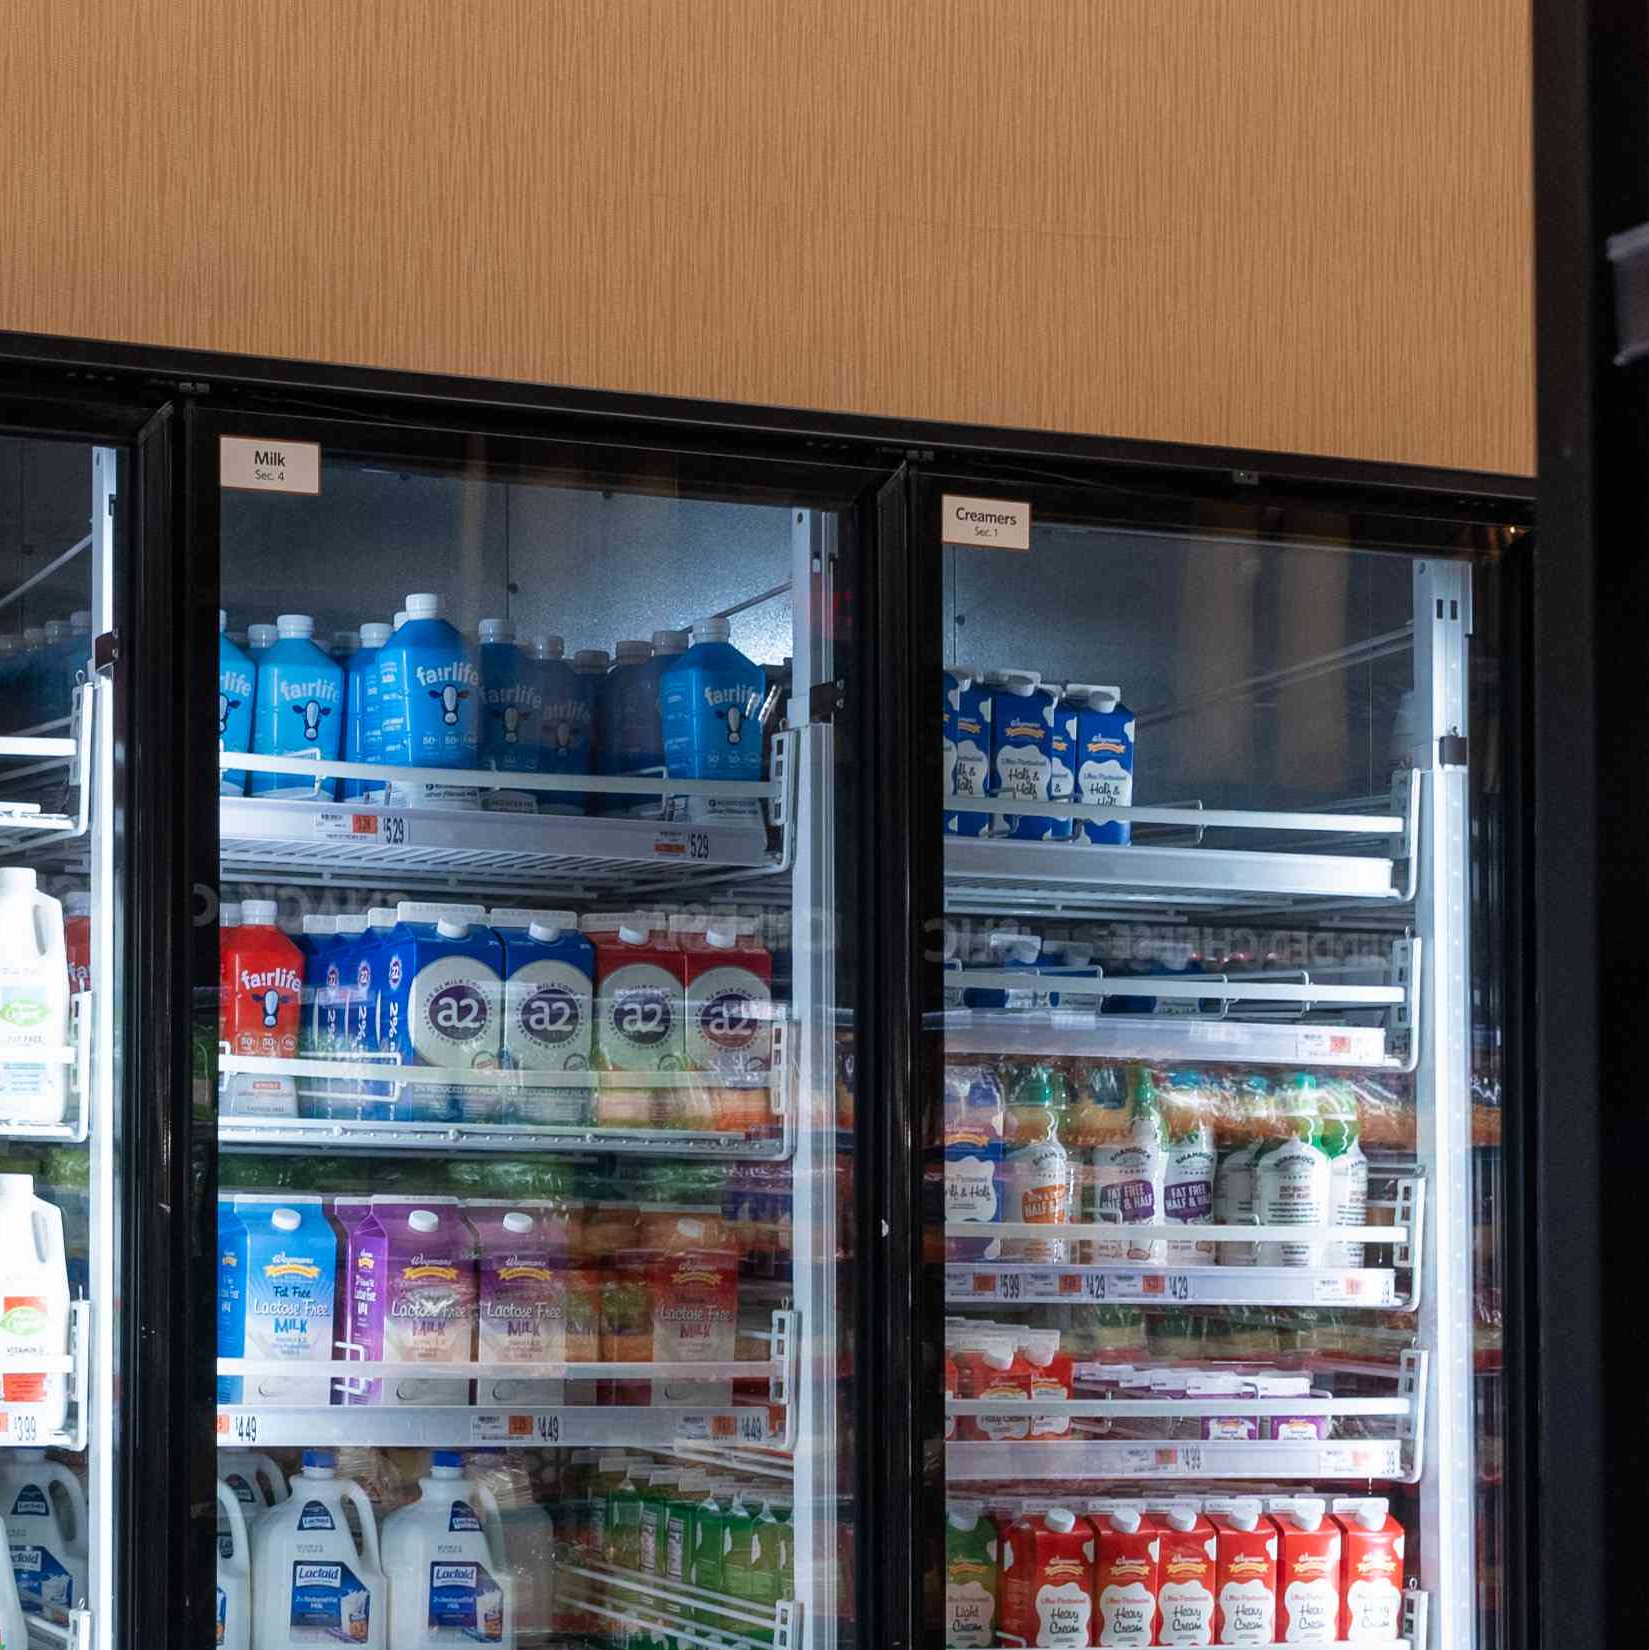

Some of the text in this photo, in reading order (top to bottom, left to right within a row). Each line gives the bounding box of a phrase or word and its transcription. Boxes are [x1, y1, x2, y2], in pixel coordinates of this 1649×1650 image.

[254, 451, 286, 468] Milk
[255, 469, 286, 482] Sec. 4
[955, 508, 1017, 526] Creamers
[416, 662, 479, 688] fairlife
[280, 678, 340, 702] fairlife
[478, 684, 542, 706] fairlife
[1008, 768, 1030, 783] Half
[241, 968, 302, 993] fairlife
[437, 996, 482, 1029] a2
[529, 1001, 575, 1031] a2
[621, 1002, 665, 1031] a2
[709, 1005, 751, 1035] a2
[1105, 1185, 1144, 1200] FAT FREE
[1170, 1185, 1207, 1198] FAT FREE
[272, 1252, 314, 1266] Wegmans
[411, 1254, 453, 1266] Wegmans
[505, 1256, 546, 1268] Wegmans
[273, 1286, 311, 1298] Fat Free
[253, 1299, 331, 1317] Lactose Free
[485, 1303, 561, 1319] Lactose Free
[660, 1306, 731, 1321] Lactose Free
[274, 1319, 307, 1334] MILK
[508, 1321, 542, 1336] MILK
[680, 1324, 710, 1339] MILK
[298, 1567, 339, 1580] Lactaid
[435, 1567, 474, 1580] Lactaid
[955, 1605, 979, 1619] Light
[1050, 1608, 1079, 1623] Heavy
[1113, 1608, 1143, 1623] Heavy
[1173, 1605, 1201, 1621] Heavy
[1234, 1604, 1263, 1620] Heavy
[952, 1619, 983, 1633] Cream
[1049, 1623, 1080, 1634] Cream
[1112, 1622, 1143, 1634] Cream
[1172, 1619, 1203, 1632] Cream
[1233, 1619, 1263, 1632] Cream
